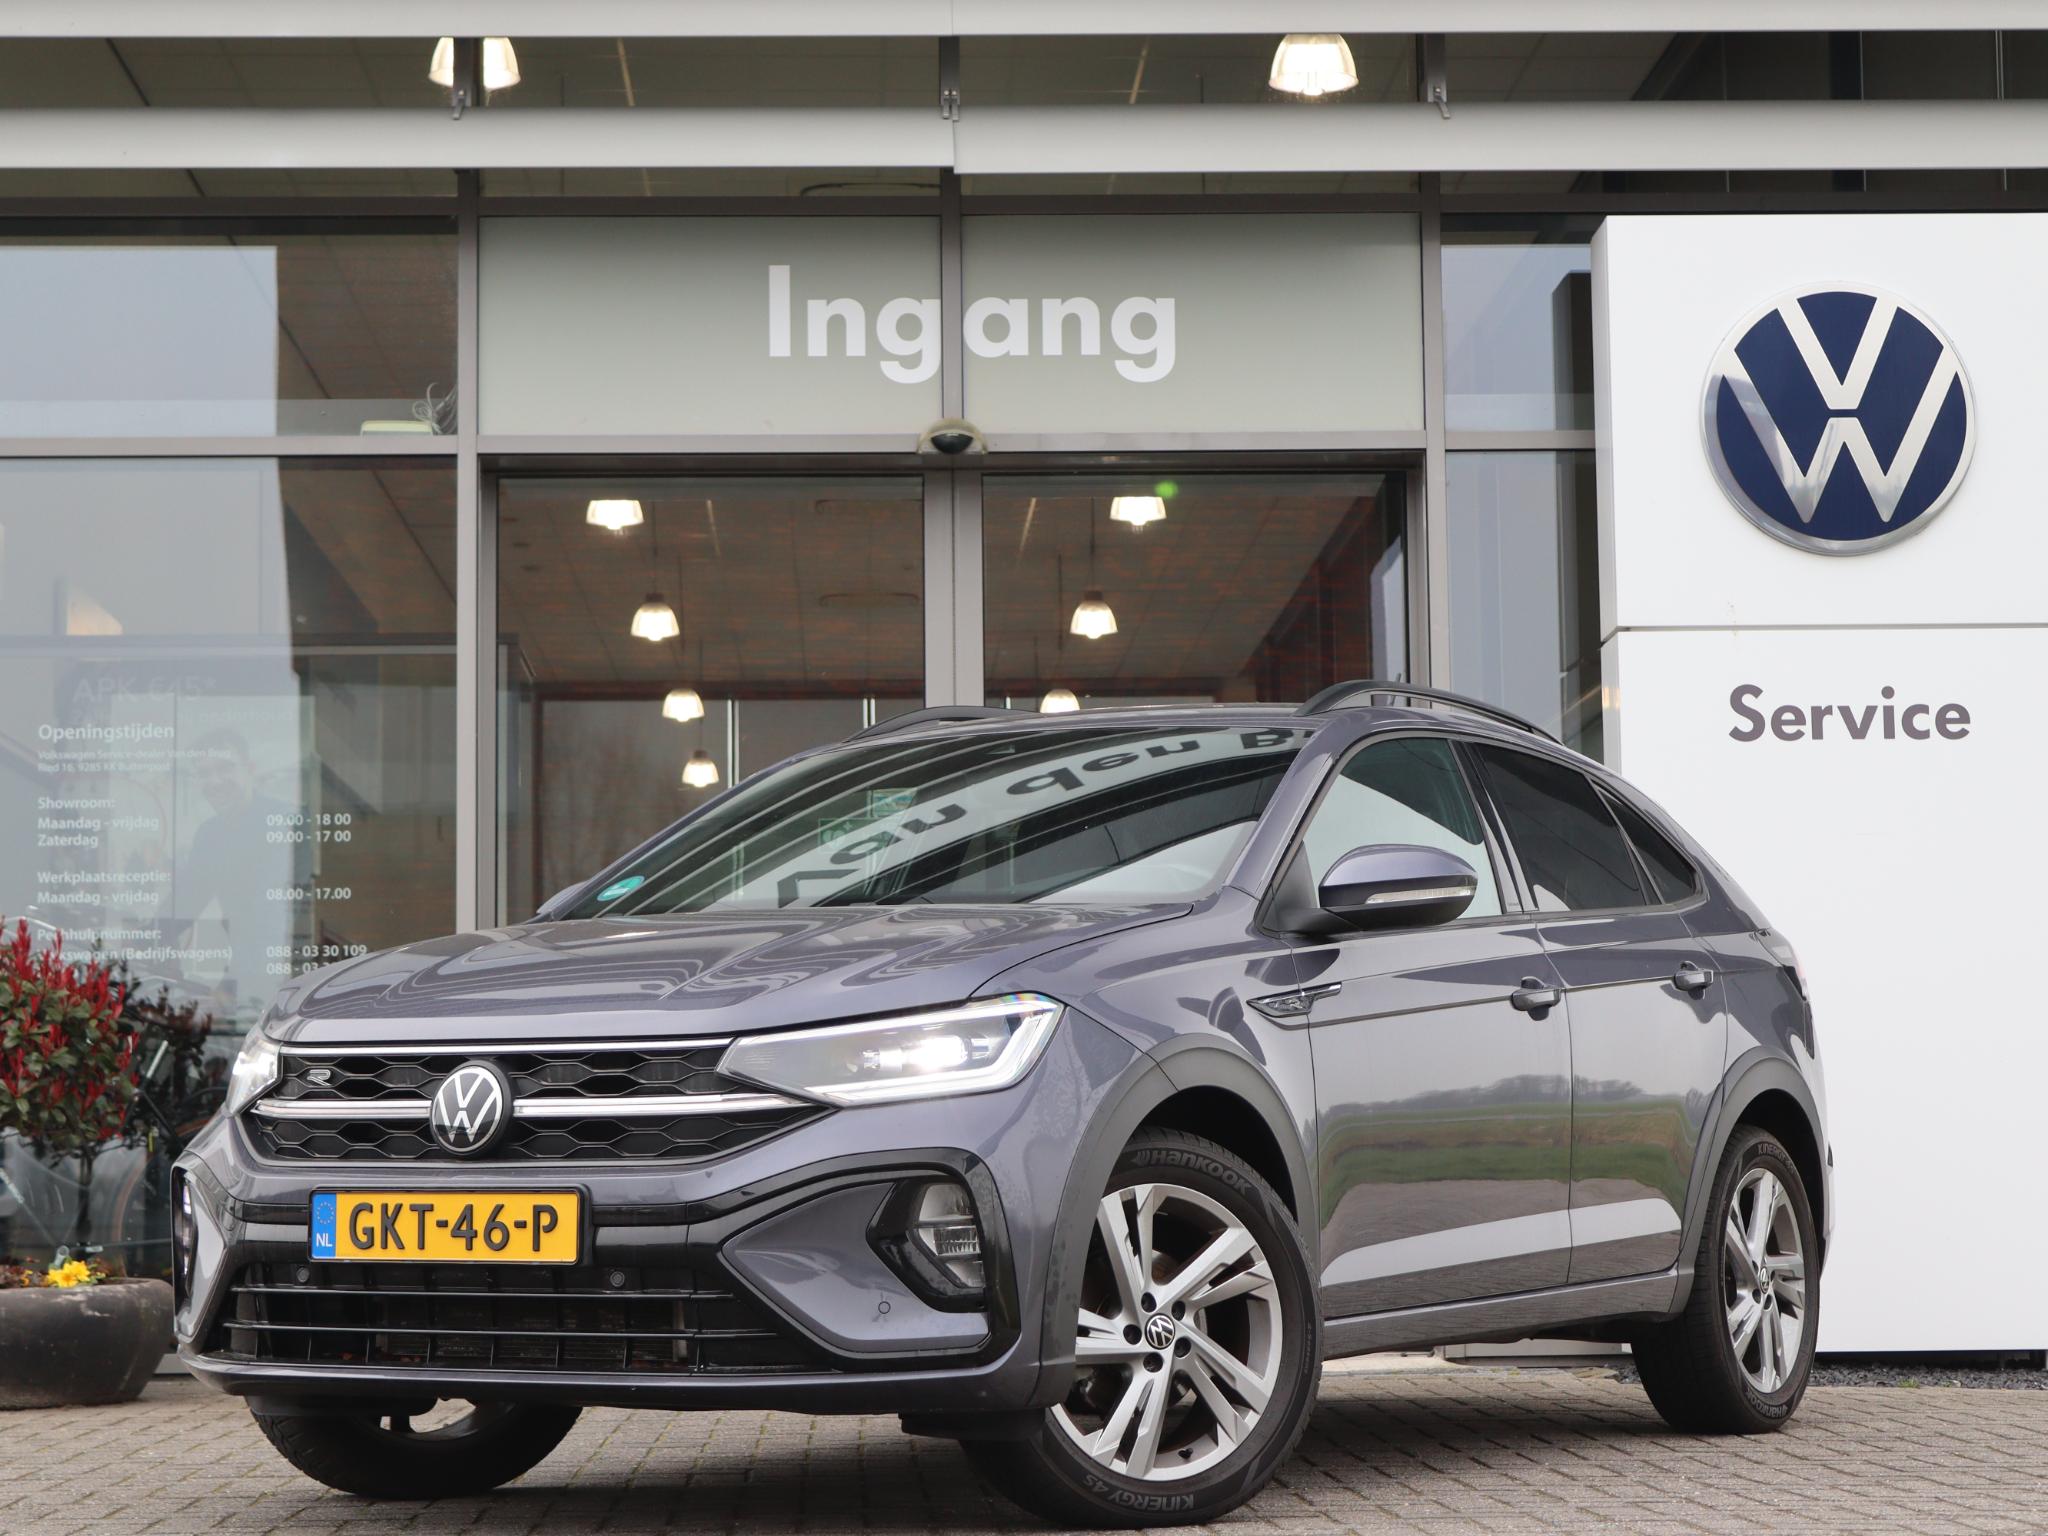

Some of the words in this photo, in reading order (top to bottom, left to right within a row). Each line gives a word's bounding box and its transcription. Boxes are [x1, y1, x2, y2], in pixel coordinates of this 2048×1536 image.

[768, 264, 1177, 385] Ingang
[1728, 684, 1972, 744] Service
[38, 723, 175, 742] Openingstijden
[38, 797, 116, 809] Showroom:
[38, 817, 101, 831] Maandag
[112, 816, 160, 832] vrijdag
[266, 814, 304, 826] 09.00
[38, 833, 99, 848] Zaterdag
[266, 831, 304, 843] 09.00
[37, 870, 171, 885] Werkplaatsreceptie:
[38, 891, 101, 906] Maandag
[112, 889, 160, 905] vrijdag
[266, 889, 304, 900] 08.00
[316, 888, 352, 899] 17.00
[38, 928, 162, 943] Pehhulpnummer:
[121, 946, 233, 962] (Bedrijfswagens)
[266, 946, 292, 958] 088
[302, 945, 319, 957] 03
[322, 945, 339, 957] 30
[343, 944, 367, 956] 109
[266, 963, 292, 975] 088
[349, 1201, 559, 1252] GKT-46-P
[315, 1232, 333, 1248] NL
[1107, 1490, 1195, 1512] KINERGY
